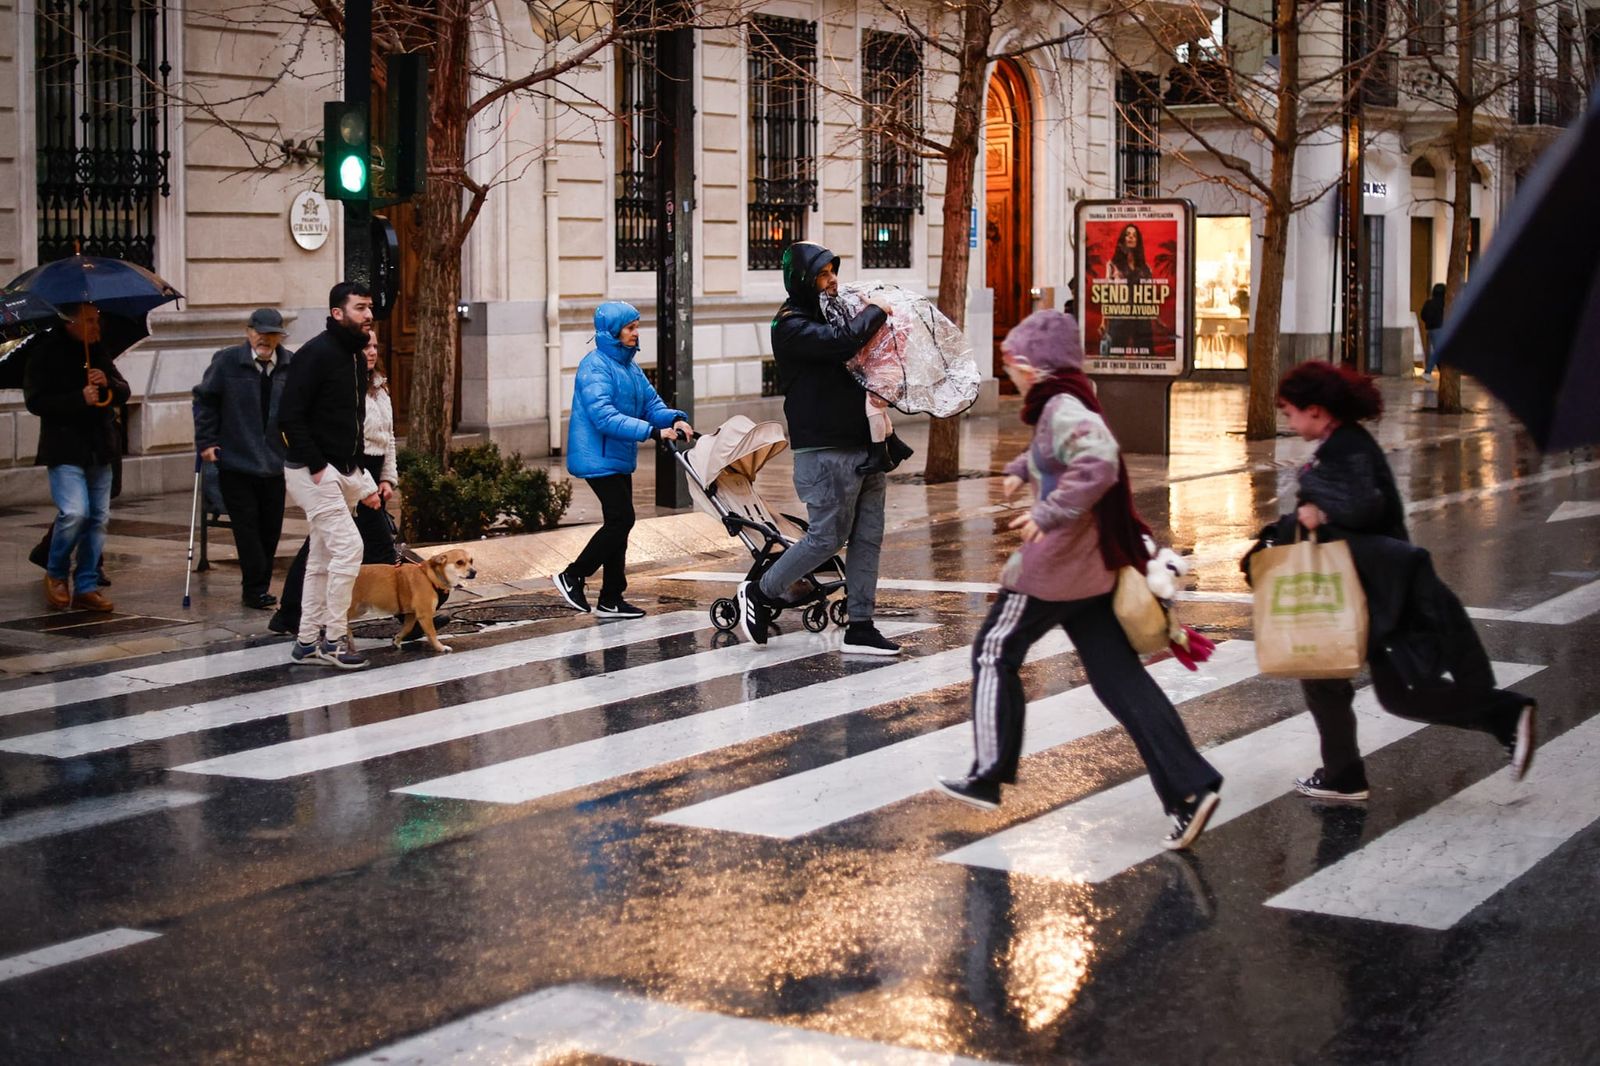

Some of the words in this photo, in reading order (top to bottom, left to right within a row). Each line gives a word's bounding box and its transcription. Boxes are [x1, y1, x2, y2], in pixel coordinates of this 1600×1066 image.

[293, 223, 314, 232] GRAN
[1091, 284, 1129, 304] SEND
[1133, 284, 1170, 304] HELP
[1101, 304, 1131, 315] (ENVIAD
[1131, 304, 1160, 315] AYUDA)
